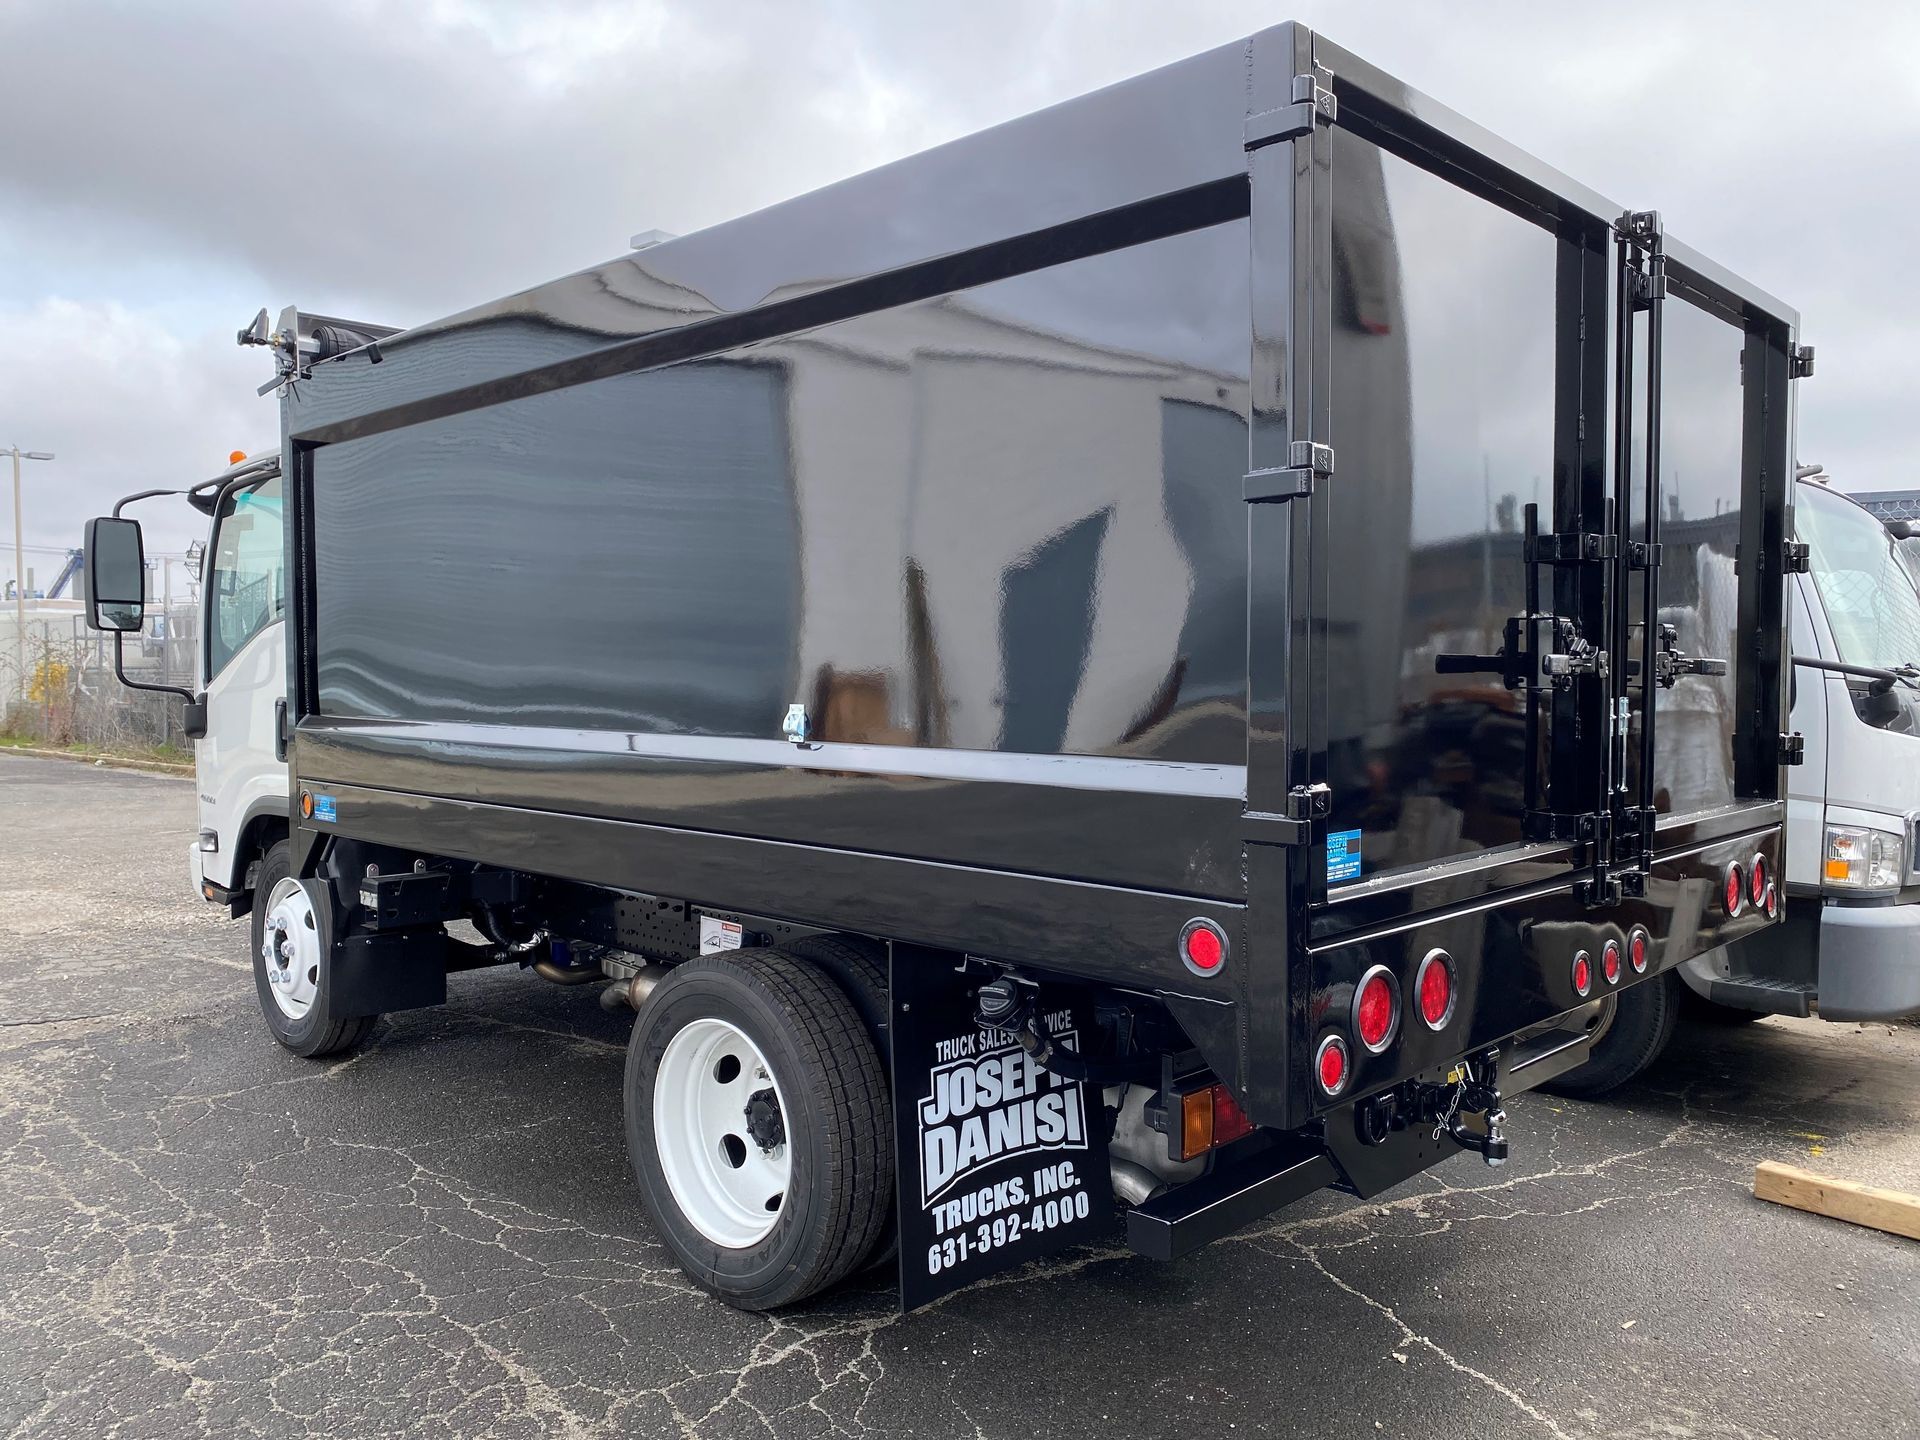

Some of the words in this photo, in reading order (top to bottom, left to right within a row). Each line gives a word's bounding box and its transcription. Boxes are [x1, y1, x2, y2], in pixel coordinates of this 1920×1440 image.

[935, 1033, 976, 1063] TRUCK
[979, 1028, 1014, 1052] SALES
[1027, 1009, 1072, 1037] SVICE
[924, 1087, 1082, 1197] DANISI
[927, 1190, 1090, 1275] 631-392-4000
[931, 1175, 1030, 1235] TRUCKS,
[1033, 1160, 1081, 1198] INC.
